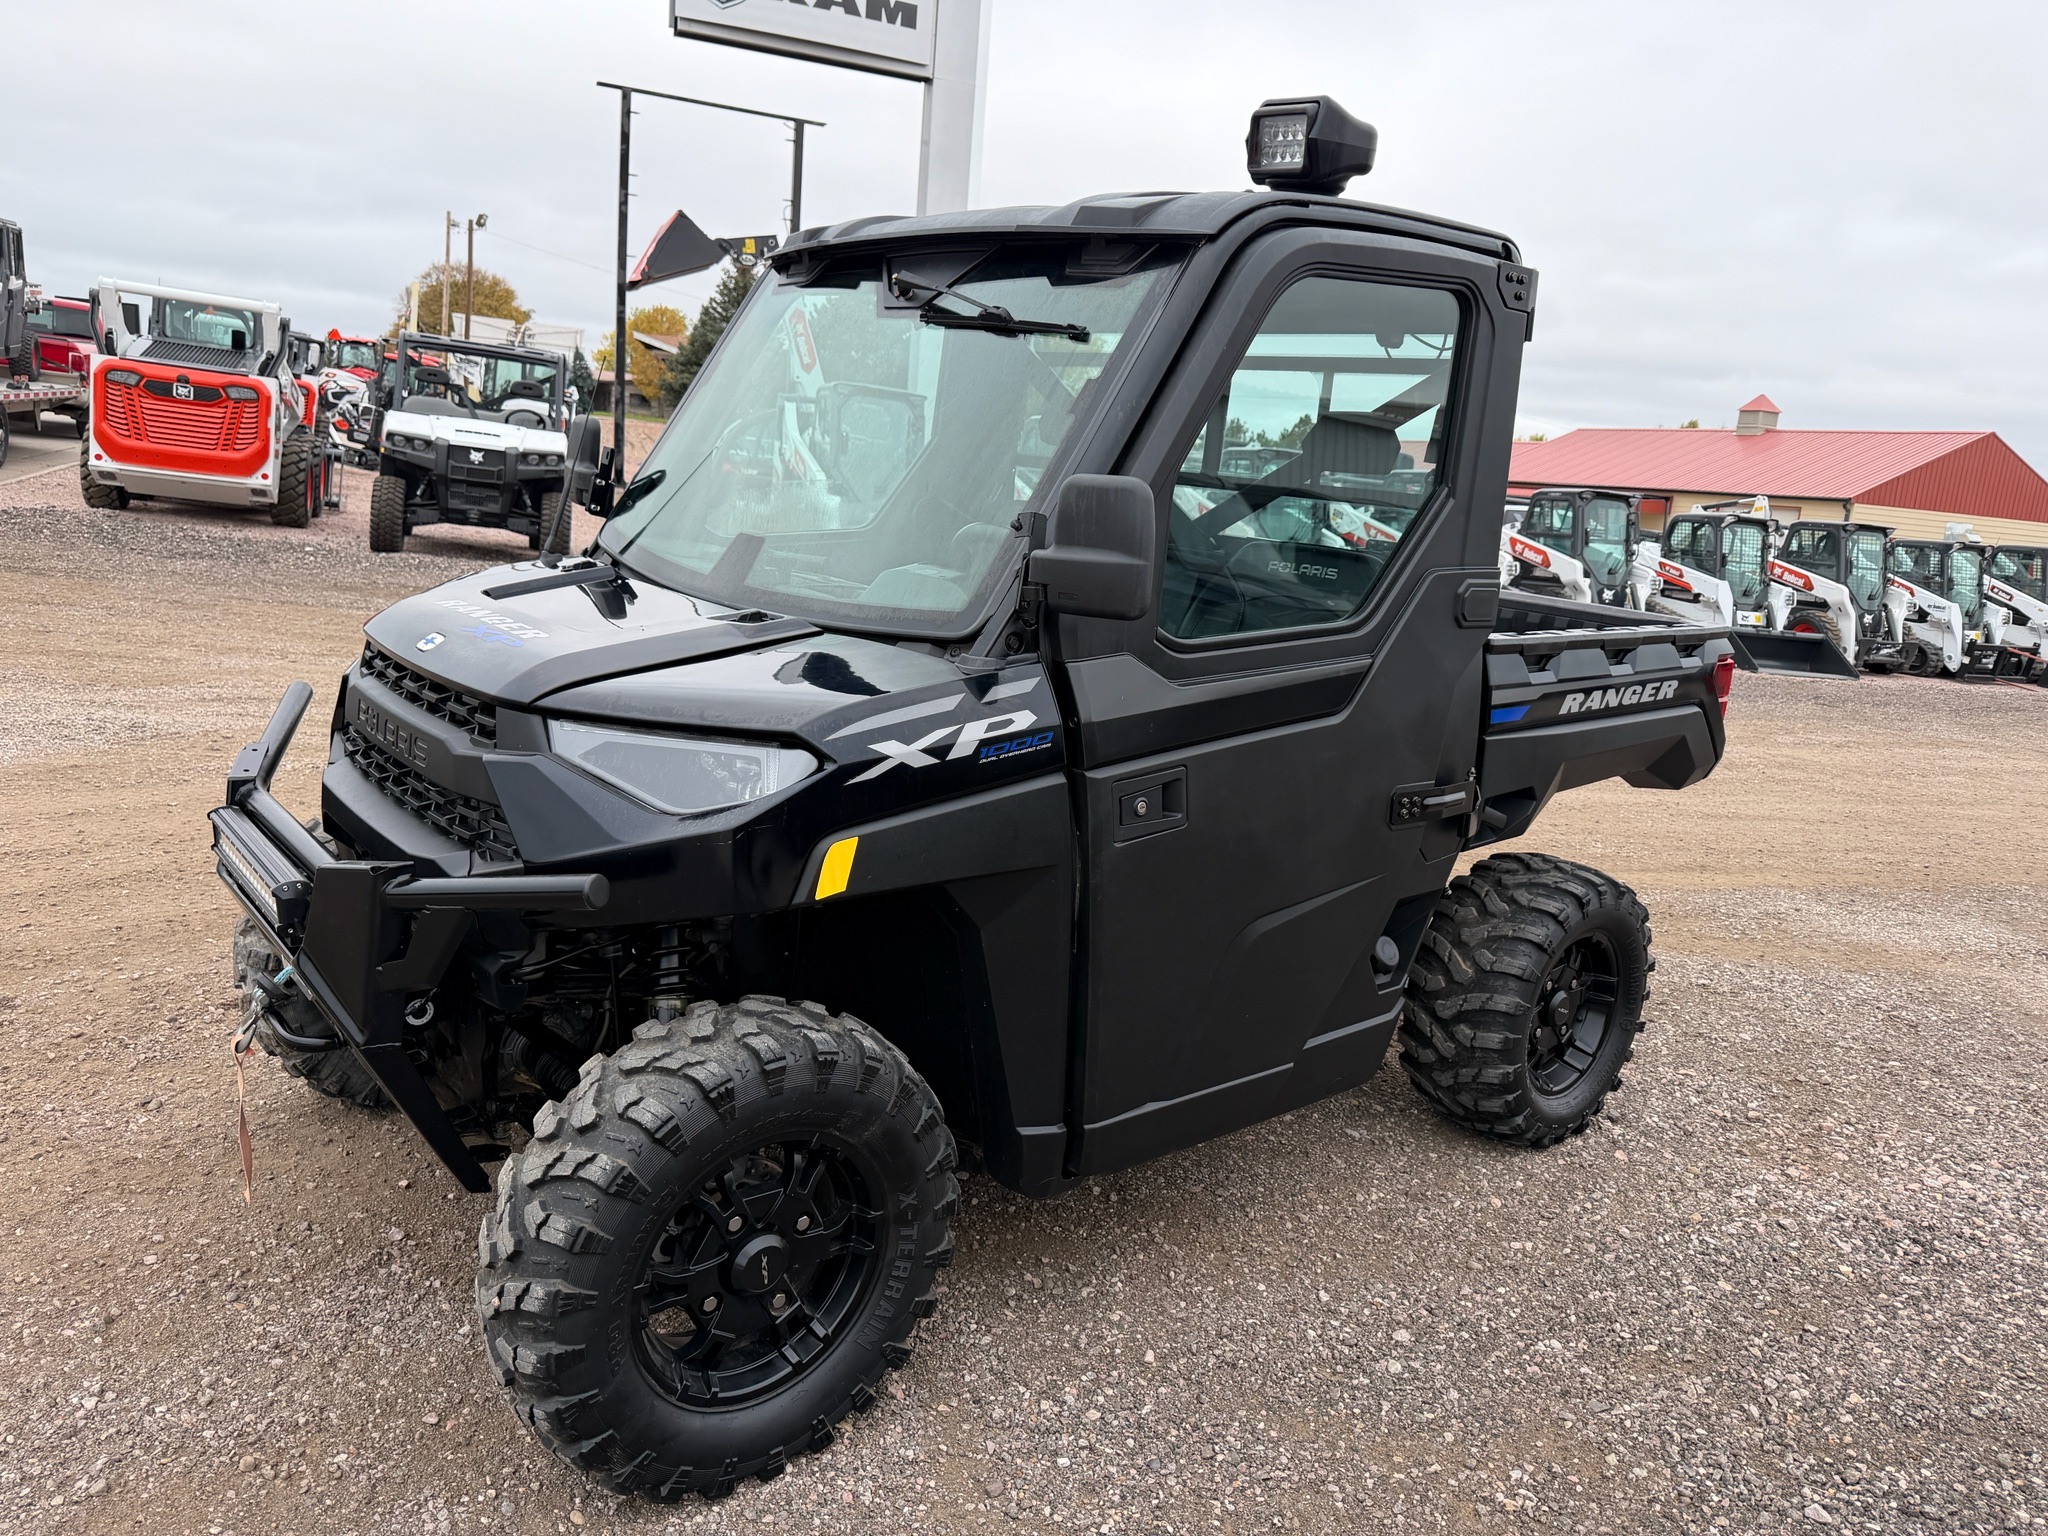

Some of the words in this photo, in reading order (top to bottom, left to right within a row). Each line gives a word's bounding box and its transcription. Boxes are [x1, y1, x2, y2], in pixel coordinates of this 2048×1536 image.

[770, 0, 919, 30] AM
[1267, 559, 1339, 580] POLARIS
[1522, 546, 1543, 565] Bobcat
[1782, 571, 1806, 588] Bobcat
[434, 599, 550, 639] RANGER
[456, 624, 525, 648] XP
[1558, 680, 1679, 715] RANGER
[356, 698, 429, 768] POLARIS
[843, 709, 1038, 786] XP
[980, 731, 1054, 758] 1000
[760, 1253, 769, 1285] XP
[854, 1190, 920, 1352] X-TERRAIN
